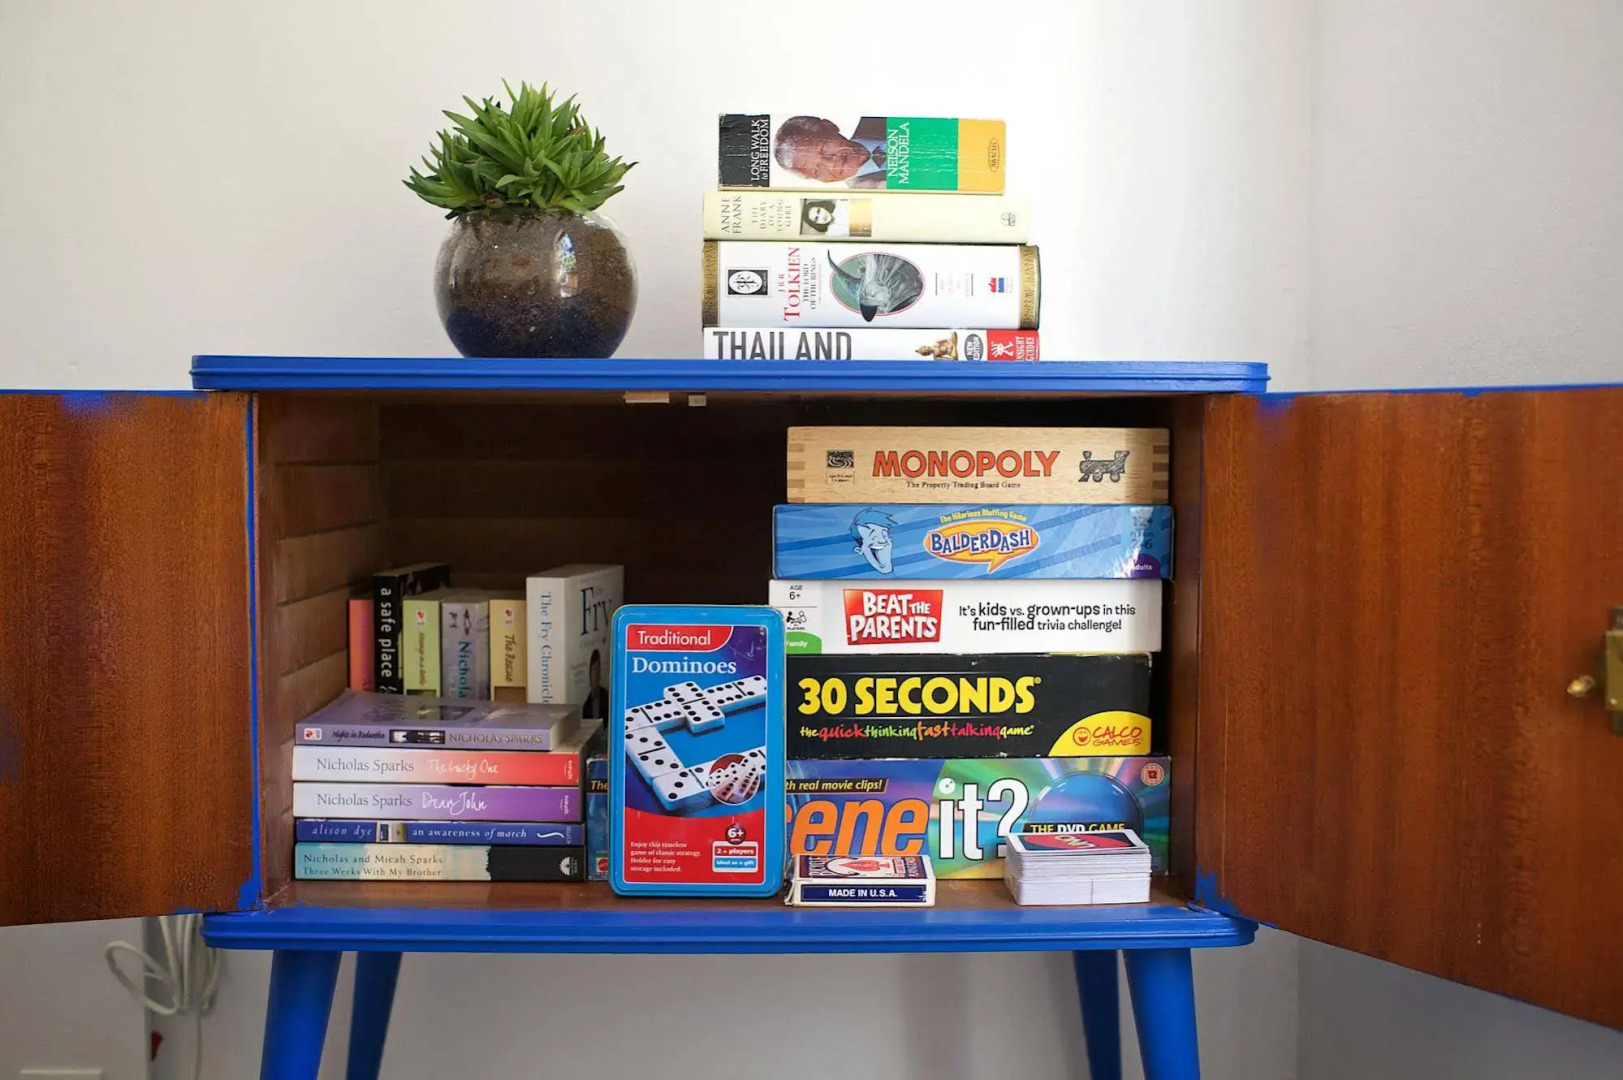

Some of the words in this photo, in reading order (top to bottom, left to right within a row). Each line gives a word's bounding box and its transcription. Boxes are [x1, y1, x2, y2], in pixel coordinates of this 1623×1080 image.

[751, 120, 760, 149] WALK
[760, 118, 769, 172] FREEDOM
[888, 129, 898, 177] NELSON
[899, 122, 910, 184] MANDELA
[751, 151, 760, 181] LONG
[761, 172, 769, 180] to
[721, 197, 730, 233] ANNE
[732, 196, 741, 234] FRANK
[784, 247, 800, 321] TOLKIEN
[713, 331, 852, 360] THAILAND
[966, 340, 974, 356] NEW
[1025, 336, 1035, 361] GUIDES
[872, 450, 1060, 478] MONOPOLY
[922, 482, 950, 490] Property
[953, 482, 978, 490] Trading
[940, 515, 952, 523] The
[952, 510, 981, 521] Hilarious
[981, 508, 1008, 519] Bluffing
[1009, 511, 1027, 523] Game
[930, 529, 1031, 554] BALDERDASH
[541, 591, 551, 616] The
[789, 591, 801, 600] 6+
[862, 591, 913, 617] BEAT
[909, 601, 931, 614] THE
[380, 602, 396, 632] safe
[580, 587, 612, 644] Fry
[959, 605, 976, 616] It's
[979, 602, 1007, 616] kids
[1010, 607, 1025, 616] vs.
[1027, 604, 1100, 619] grown-ups
[1103, 604, 1112, 615] in
[1115, 604, 1136, 616] this
[538, 622, 552, 641] Fry
[850, 615, 938, 642] PARENTS
[973, 617, 1035, 631] fun-filled
[1037, 619, 1065, 630] trivia
[1068, 619, 1122, 632] challenge!
[505, 634, 516, 653] The
[637, 629, 711, 646] Traditional
[378, 639, 396, 677] place
[632, 656, 737, 674] Dominoes
[458, 641, 471, 698] Nichola
[504, 653, 516, 683] Rescue
[542, 645, 553, 704] Chronicl
[798, 677, 848, 715] 30
[449, 733, 503, 743] NICHOLAS
[505, 734, 542, 744] SPARKS
[1092, 726, 1142, 739] CALCO
[1092, 738, 1142, 746] GAMES
[316, 758, 370, 771] Nicholas
[373, 759, 414, 774] Sparks
[429, 759, 446, 773] The
[448, 759, 477, 780] Lucky
[480, 759, 499, 774] One
[591, 780, 608, 790] The
[798, 780, 820, 790] real
[821, 780, 853, 790] movie
[855, 779, 883, 792] clips!
[317, 793, 368, 806] Nicholas
[372, 794, 413, 809] Sparks
[422, 792, 451, 810] Dear
[450, 792, 488, 816] John
[786, 799, 930, 856] ene
[938, 777, 1029, 861] it?
[1030, 824, 1054, 833] THE
[1057, 824, 1086, 833] DVD
[312, 824, 347, 835] alison
[354, 825, 372, 839] dye
[484, 829, 495, 840] of
[497, 829, 527, 838] march
[727, 828, 744, 838] 6+
[630, 841, 648, 849] Enjoy
[304, 854, 348, 863] Nicholas
[352, 854, 370, 863] and
[375, 854, 406, 864] Micah
[410, 854, 443, 865] Sparks
[304, 867, 329, 875] Three
[332, 867, 360, 875] Weeks
[362, 867, 386, 876] With
[390, 868, 402, 878] My
[406, 868, 442, 876] Brother
[828, 889, 856, 898] MADE
[858, 889, 867, 897] IN
[869, 889, 898, 898] U.S.A.
